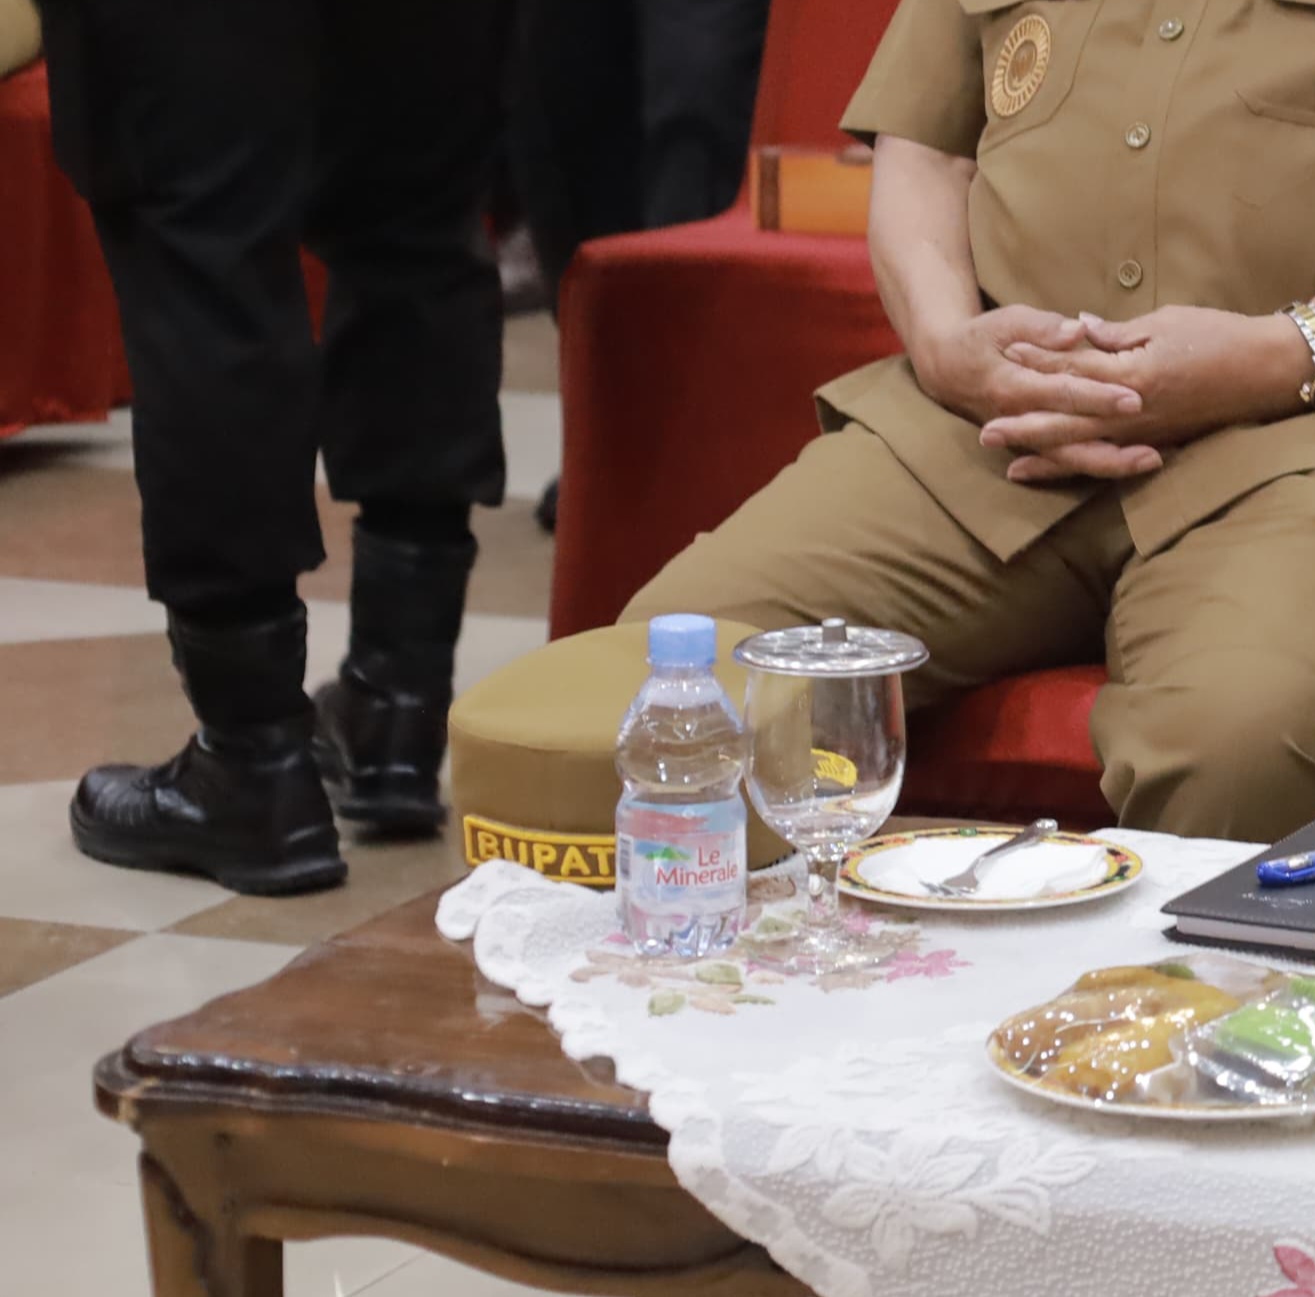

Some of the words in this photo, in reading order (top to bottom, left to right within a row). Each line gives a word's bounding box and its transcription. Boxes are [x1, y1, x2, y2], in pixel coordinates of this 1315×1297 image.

[477, 830, 616, 876] BUPAT
[698, 846, 720, 867] Le
[655, 859, 738, 887] Minerale
